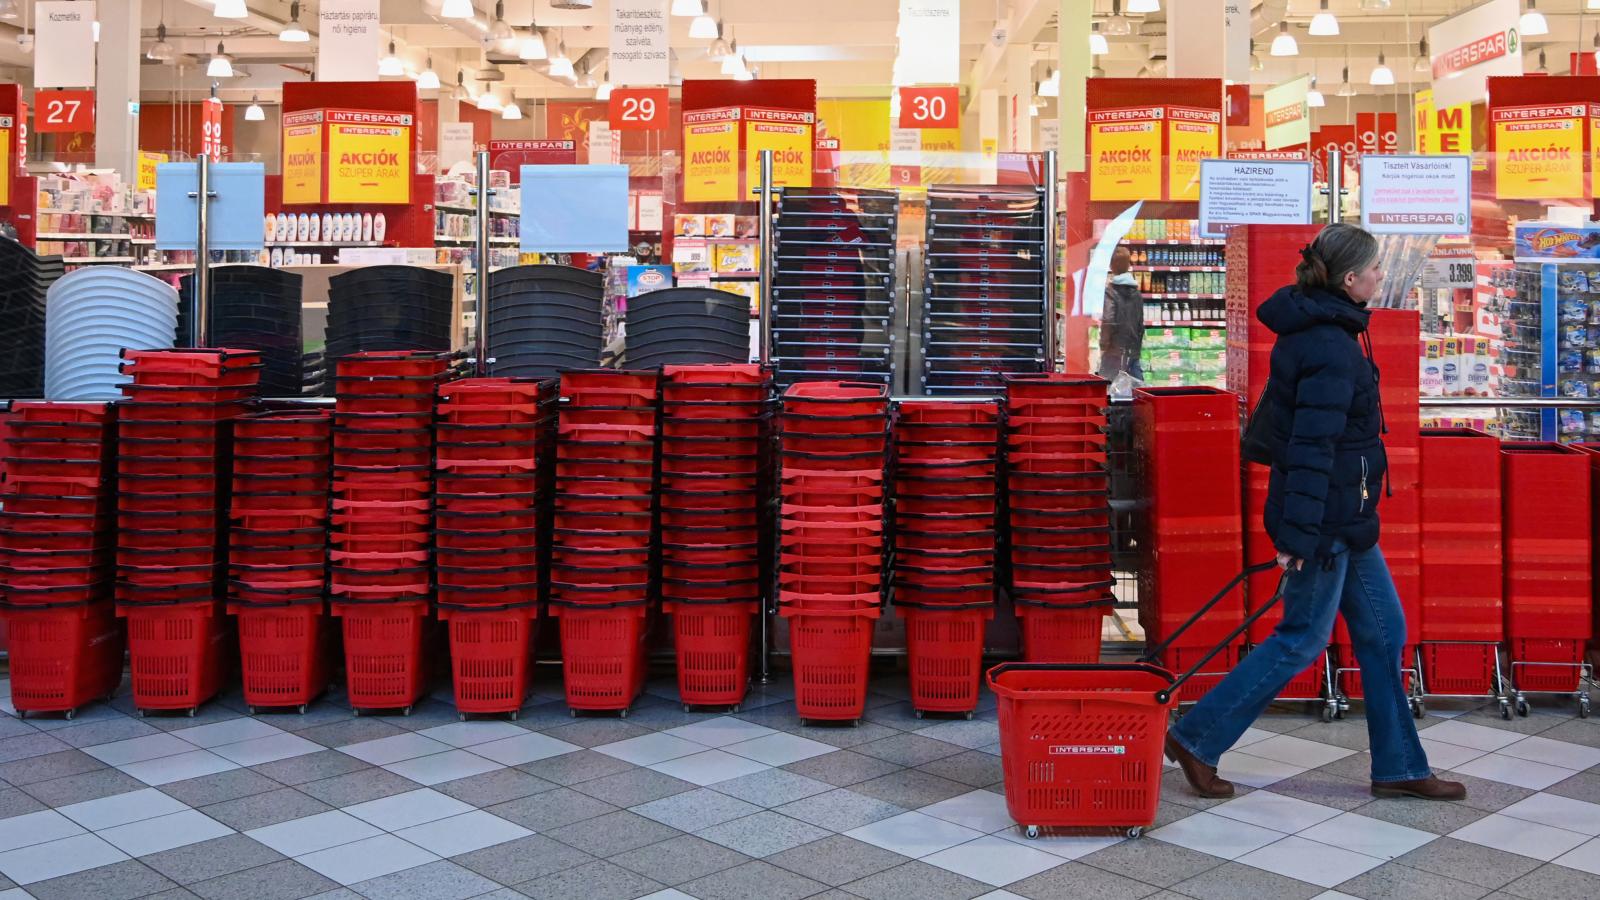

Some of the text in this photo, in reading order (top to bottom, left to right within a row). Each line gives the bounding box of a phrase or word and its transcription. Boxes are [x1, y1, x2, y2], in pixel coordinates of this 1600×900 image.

[49, 13, 81, 22] Kozmetika
[47, 100, 81, 123] 27
[622, 98, 655, 121] 29
[912, 96, 946, 120] 30
[334, 113, 401, 123] INTERSPAR
[687, 112, 732, 122] INTERSPAR
[750, 111, 805, 121] INTERSPAR
[1095, 110, 1153, 120] INTERSPAR
[1172, 110, 1213, 120] INTERSPAR
[1500, 108, 1572, 119] INTERSPAR
[286, 113, 317, 125] INTERSPAR
[343, 127, 392, 135] INTERSPAR
[757, 125, 798, 133] INTERSPAR
[1178, 124, 1208, 132] INTERSPAR
[1510, 122, 1562, 131] INTERSPAR
[691, 146, 731, 165] AKCIÓK
[755, 147, 804, 164] ACIÓK
[1099, 145, 1152, 163] AKCIÓK
[1233, 152, 1293, 160] INTERSPAR
[1507, 143, 1571, 161] AKCIÓK
[288, 149, 316, 166] AKCIÓK
[340, 149, 399, 166] AKCIÓK
[1383, 161, 1409, 170] Tisztelt
[339, 167, 400, 178] SZUPER ÁRAK
[1381, 214, 1454, 223] INTERSPAR
